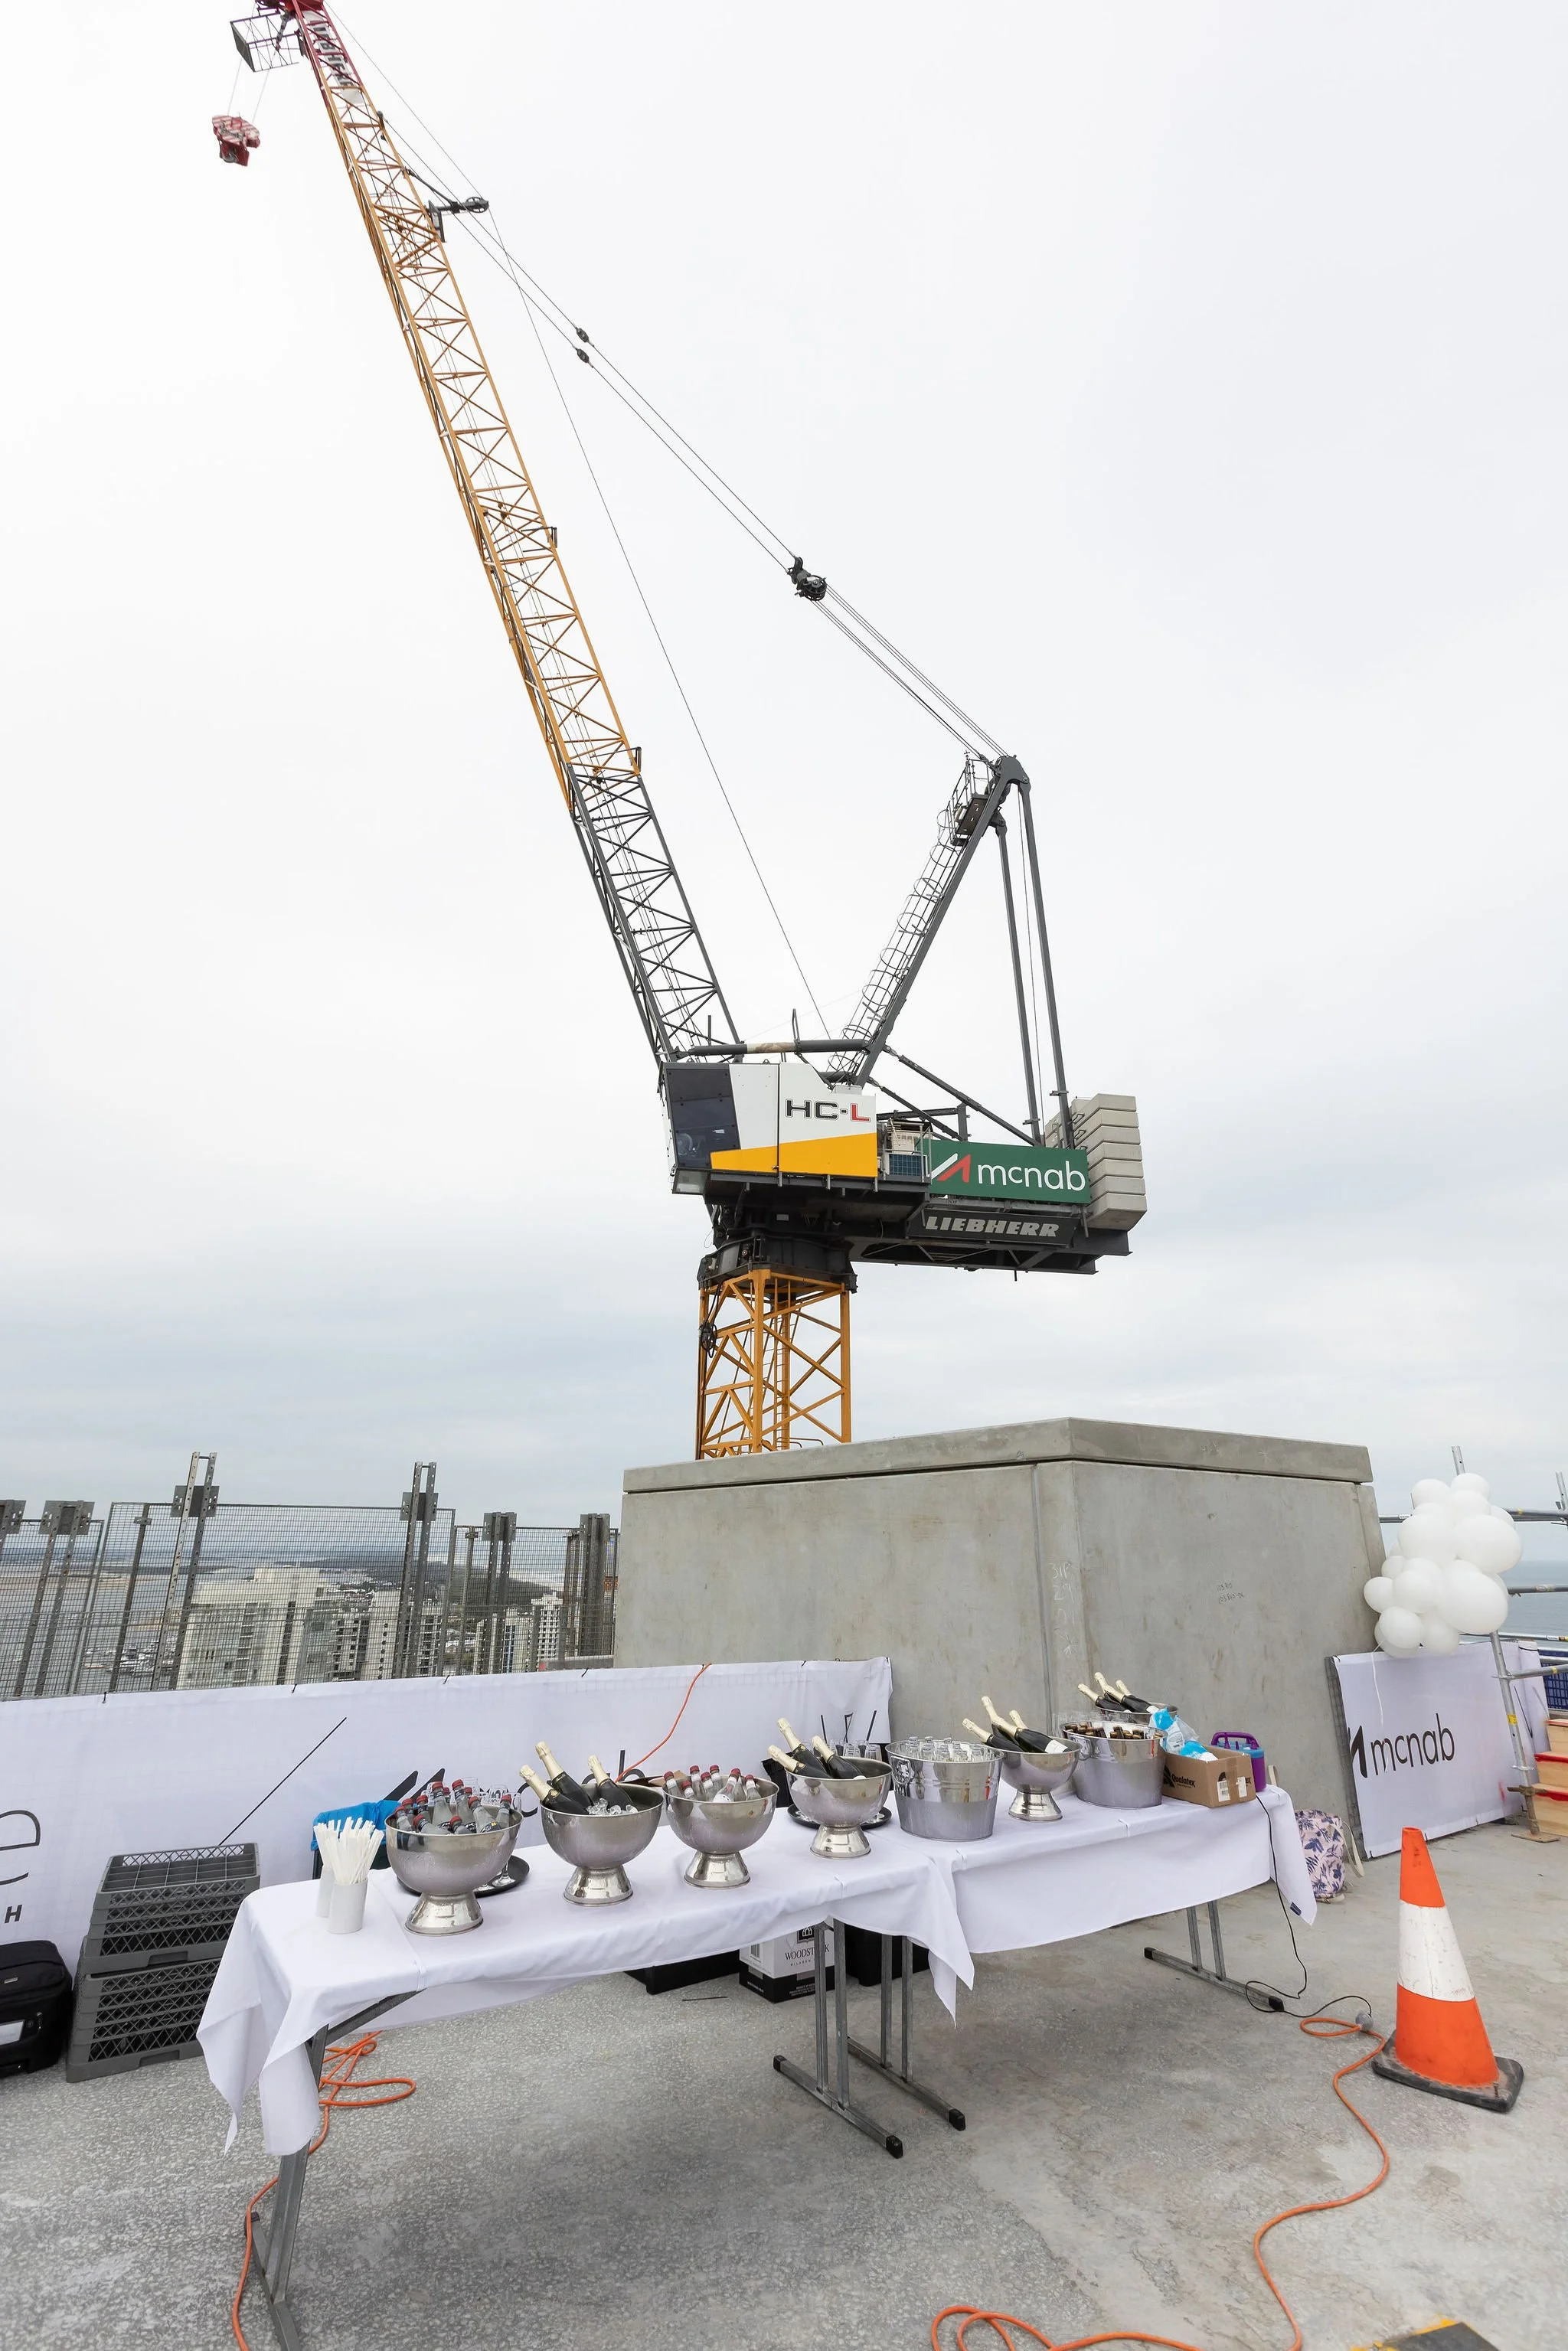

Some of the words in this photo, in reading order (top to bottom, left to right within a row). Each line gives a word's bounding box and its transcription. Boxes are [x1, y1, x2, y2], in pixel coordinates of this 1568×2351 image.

[786, 1099, 871, 1122] HC-L
[978, 1161, 1086, 1191] mcnab
[925, 1216, 1060, 1237] LIEBHERR
[1370, 1713, 1455, 1776] mcnab
[785, 1944, 830, 1961] WOODSTK
